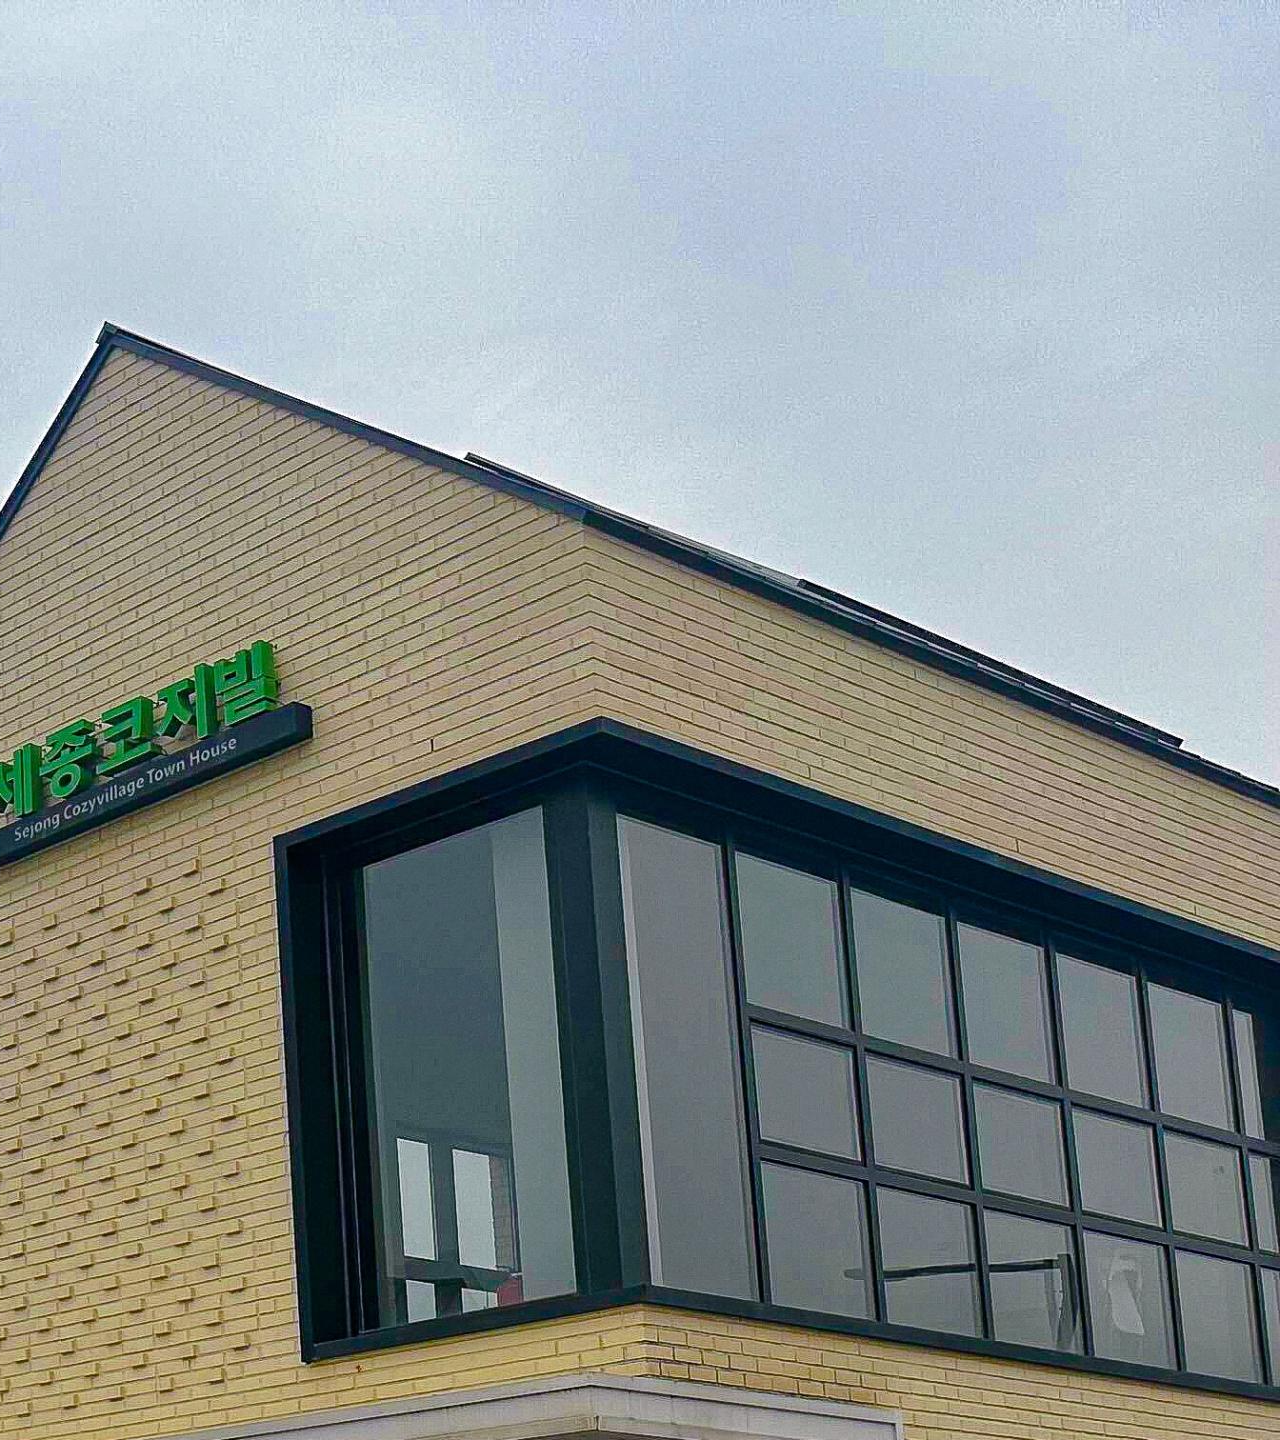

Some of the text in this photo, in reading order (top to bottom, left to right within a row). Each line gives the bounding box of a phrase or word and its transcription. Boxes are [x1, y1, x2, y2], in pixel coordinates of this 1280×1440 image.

[13, 737, 238, 842] Sejong Cozyvillage Town House
